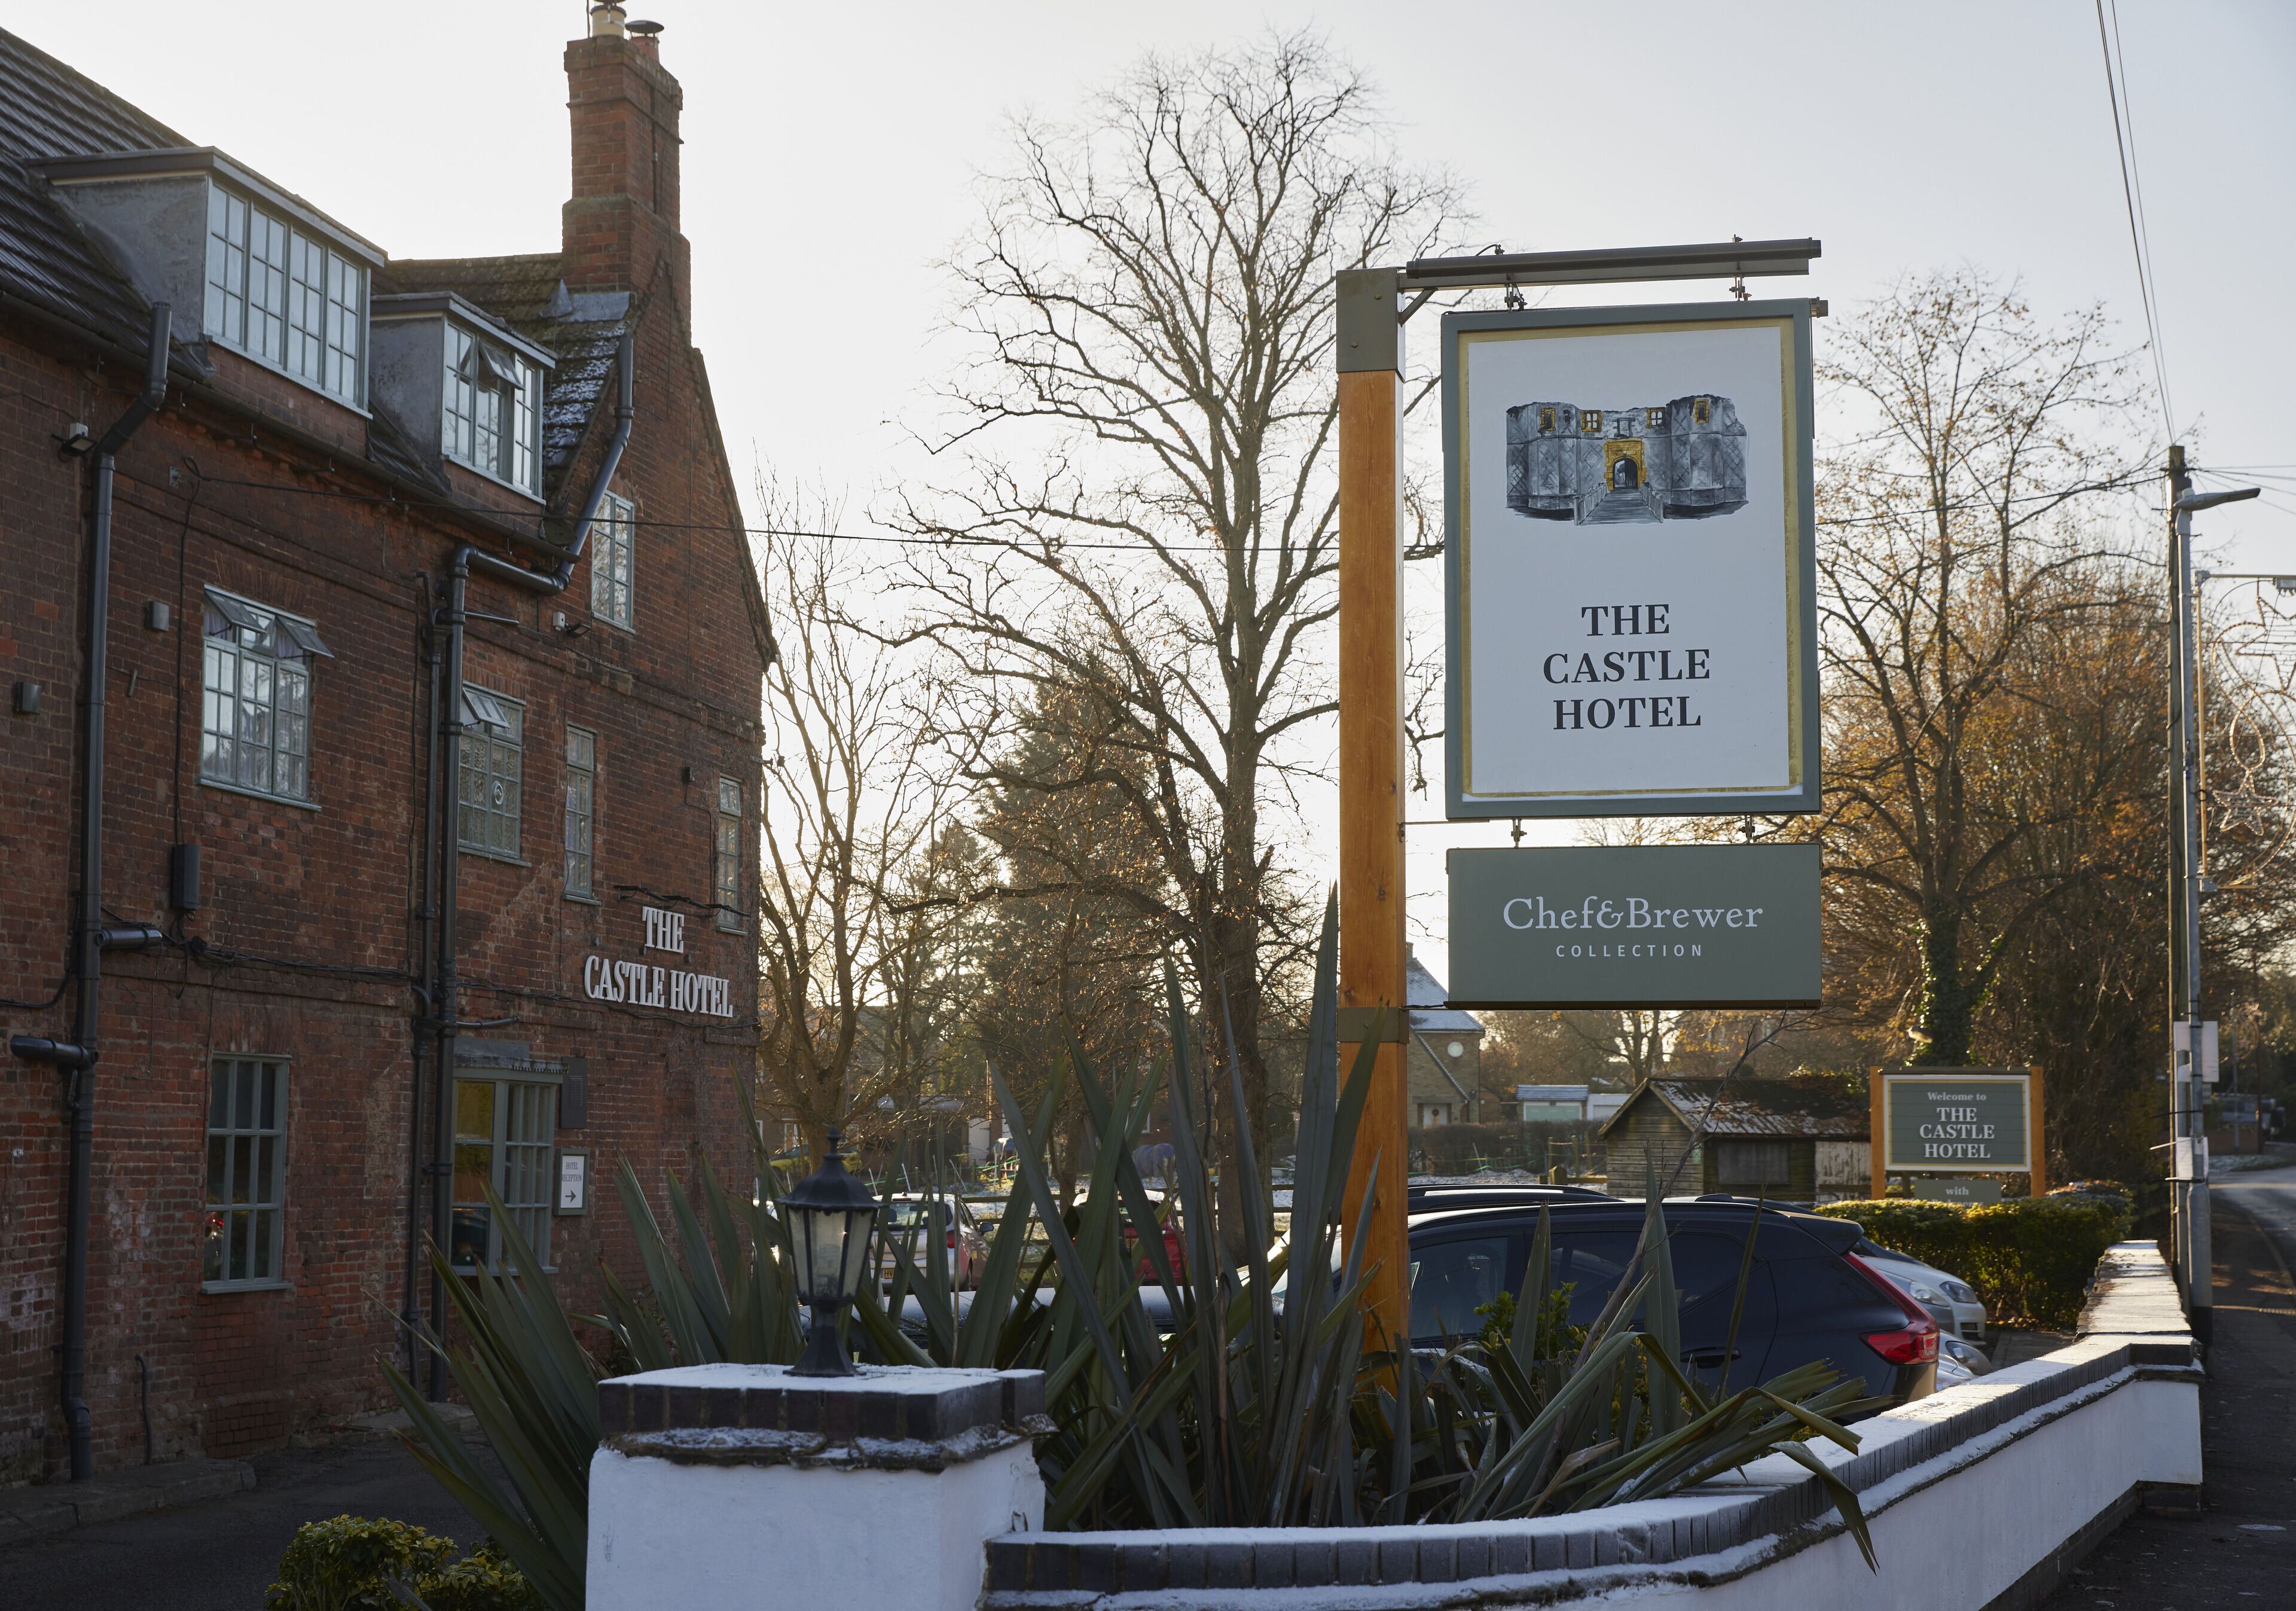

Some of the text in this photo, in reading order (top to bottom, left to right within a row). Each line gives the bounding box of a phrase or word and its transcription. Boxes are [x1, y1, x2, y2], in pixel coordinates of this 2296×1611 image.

[1581, 603, 1669, 636] THE
[1543, 649, 1710, 684] CASTLE
[1553, 696, 1701, 730] HOTEL
[1503, 896, 1763, 929] Chef&Brewer
[642, 906, 684, 953] THE
[1556, 944, 1702, 957] COLLECTION
[584, 956, 733, 1018] CASTLE HOTEL
[1928, 1092, 1973, 1100] Welcome
[1937, 1107, 1977, 1122] THE
[1919, 1124, 1994, 1139] CASTLE
[1924, 1143, 1990, 1158] HOTEL
[561, 1174, 582, 1182] RECEPTION
[1946, 1186, 1969, 1195] with
